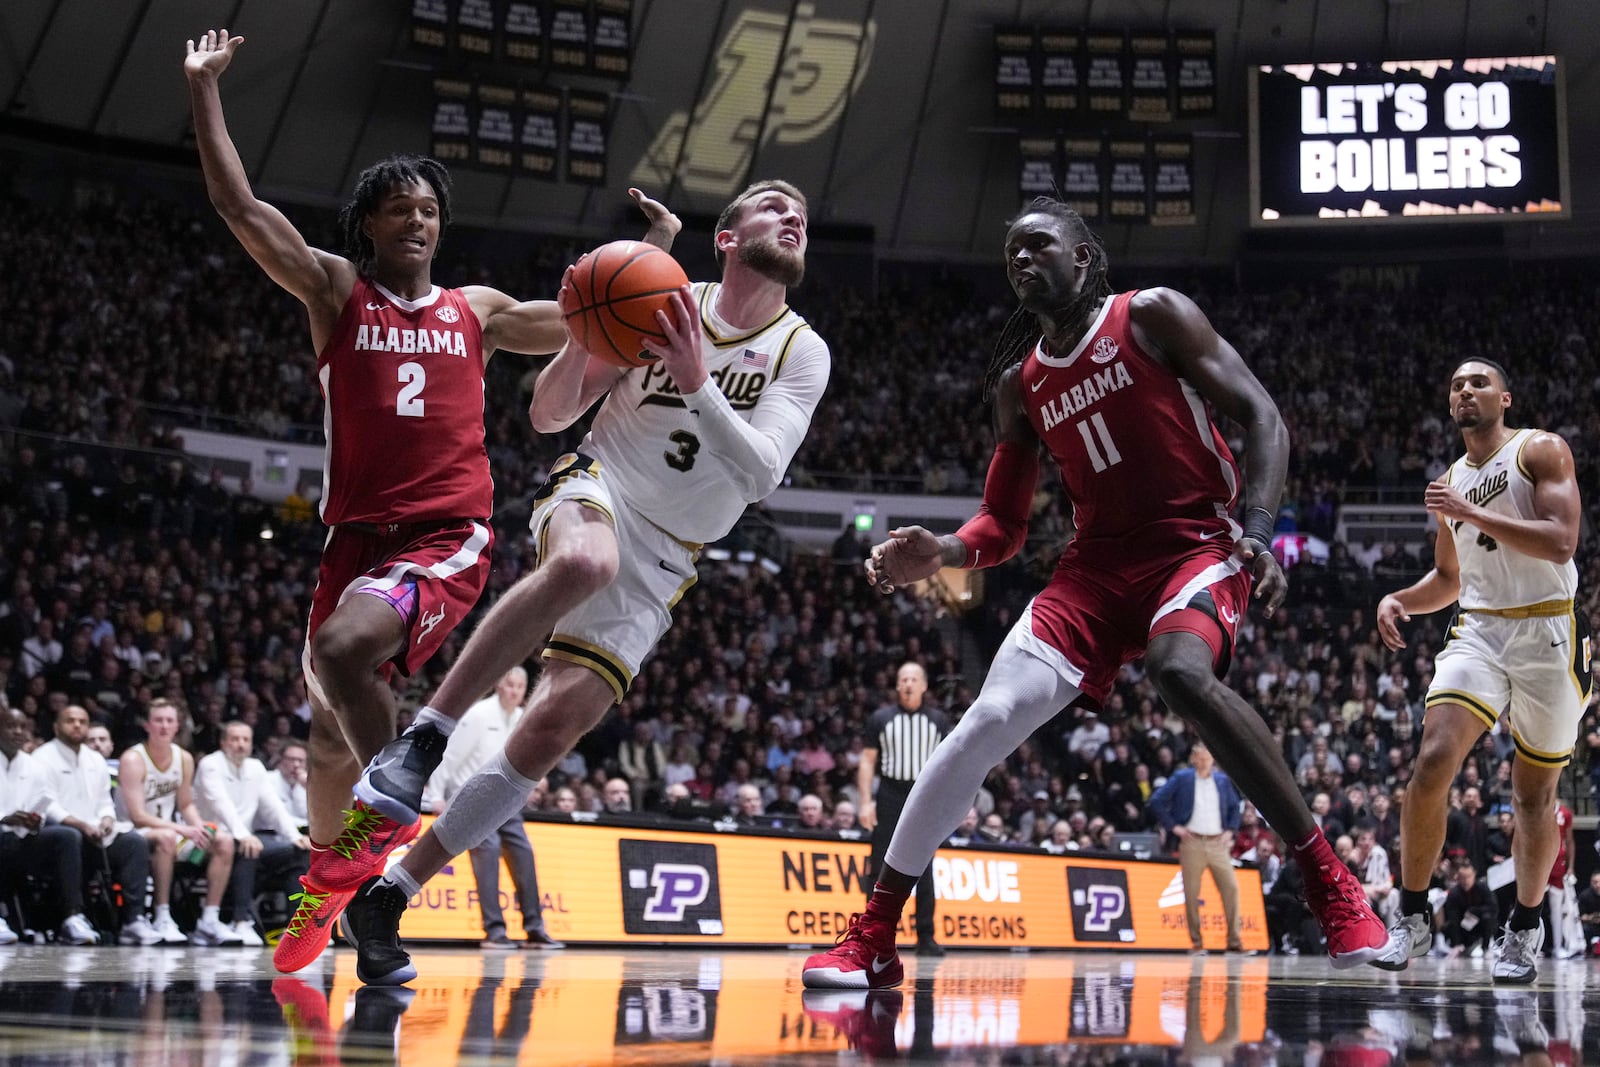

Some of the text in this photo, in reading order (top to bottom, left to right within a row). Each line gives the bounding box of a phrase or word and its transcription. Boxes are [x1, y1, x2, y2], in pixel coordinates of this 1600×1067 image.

[1301, 81, 1511, 134] LET'S GO
[1300, 135, 1522, 194] BOILERS
[437, 307, 458, 321] SEC
[355, 325, 467, 358] ALABAMA
[396, 361, 426, 417] 2
[1040, 361, 1134, 432] ALABAMA
[663, 429, 701, 472] 3
[1076, 411, 1123, 473] 11
[408, 889, 456, 909] DUE
[644, 863, 709, 921] P
[931, 857, 1021, 903] RDUE
[787, 911, 849, 935] CRED
[943, 915, 1027, 939] DESIGNS
[1084, 885, 1125, 931] P
